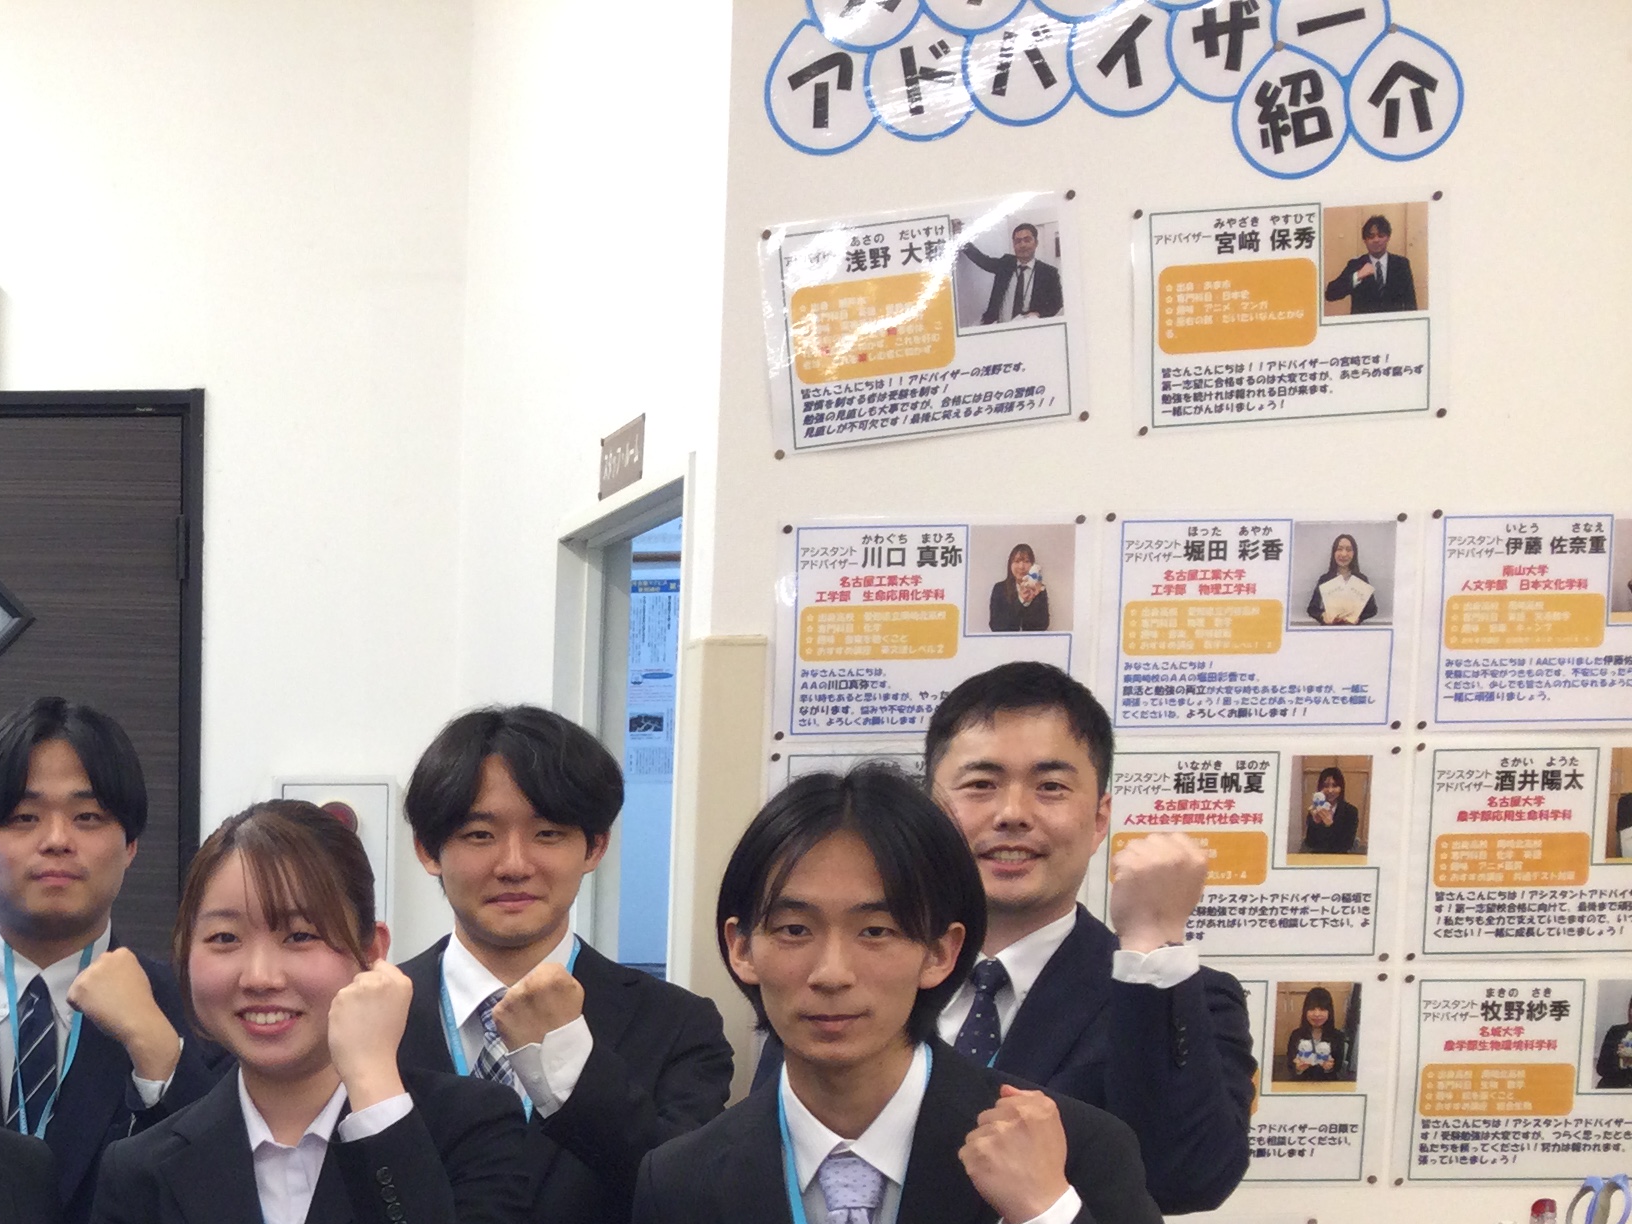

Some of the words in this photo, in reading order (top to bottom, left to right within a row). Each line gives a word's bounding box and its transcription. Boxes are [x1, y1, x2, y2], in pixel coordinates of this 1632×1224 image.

[787, 0, 1366, 129] アドバイザー
[1255, 60, 1439, 154] 紹介
[1213, 216, 1260, 229] みやざき
[1270, 212, 1316, 225] やすひで
[850, 232, 884, 247] あさの
[899, 225, 945, 241] だいすけ
[1154, 233, 1212, 245] アドバイザー
[1270, 226, 1316, 251] 保秀
[845, 248, 891, 272] 浅野
[800, 361, 1027, 399] 皆さんこんにちは！！アドバイザーの浅野です。
[1161, 399, 1285, 417] 一緒にがんばりましょう！
[1187, 526, 1222, 537] ほった
[1238, 525, 1273, 536] あやか
[1506, 523, 1540, 533] いとう
[1571, 522, 1605, 533] さなえ
[861, 532, 908, 545] かわぐち
[922, 532, 956, 544] まひろ
[1125, 539, 1182, 550] アシスタント
[1183, 540, 1227, 562] 堀田
[1238, 538, 1284, 561] 彩香
[1447, 536, 1503, 546] アシスタント
[1505, 537, 1542, 555] 伊藤
[800, 546, 857, 557] アシスタント
[861, 546, 906, 568] 川口
[917, 545, 963, 568] 真弥
[1124, 551, 1183, 563] アドバイザー
[1447, 548, 1505, 559] アドバイザー
[800, 558, 858, 570] アドバイザー
[1502, 564, 1549, 577] 南山大学
[839, 575, 923, 588] 名古屋工業大学
[1164, 569, 1246, 582] 名古屋工業大学
[1151, 584, 1186, 596] 工学部
[1198, 582, 1257, 595] 物理工学科
[1461, 579, 1508, 591] 人文学部
[1519, 578, 1588, 591] 日本文化学科
[815, 590, 851, 603] 工学部
[862, 588, 945, 602] 生命応用化学科
[1124, 661, 1213, 671] みなさんこんにちは！
[800, 668, 887, 678] みなさんこんにちは。
[798, 715, 924, 727] さい。よろしくお願いします！
[1177, 760, 1222, 770] いながき
[1236, 760, 1270, 771] ほのか
[1500, 757, 1534, 768] さかい
[1546, 757, 1579, 767] ようた
[1114, 772, 1170, 783] アシスタント
[1173, 771, 1266, 795] 稲垣帆夏
[1436, 770, 1493, 780] アシスタント
[1494, 769, 1585, 792] 酒井陽太
[1436, 782, 1494, 792] アドバイザー
[1114, 785, 1171, 795] アドバイザー
[1154, 799, 1236, 811] 名古屋市立大学
[1487, 795, 1546, 808] 名古屋大学
[1123, 813, 1263, 825] 人文社会学部現代社会学科
[1456, 810, 1573, 823] 農学部応用生命科学科
[1185, 918, 1370, 929] とがあればいつでも相談して下さい。よ
[1185, 931, 1205, 941] ます
[1486, 988, 1519, 998] まきの
[1531, 988, 1552, 998] さき
[1423, 1000, 1478, 1009] アシスタント
[1480, 1000, 1571, 1022] 牧野紗季
[1423, 1012, 1479, 1022] アドバイザー
[1479, 1026, 1525, 1037] 名城大学
[1444, 1040, 1558, 1051] 農学部生物環境科学科
[1418, 1154, 1518, 1165] 張っていきましょう！
